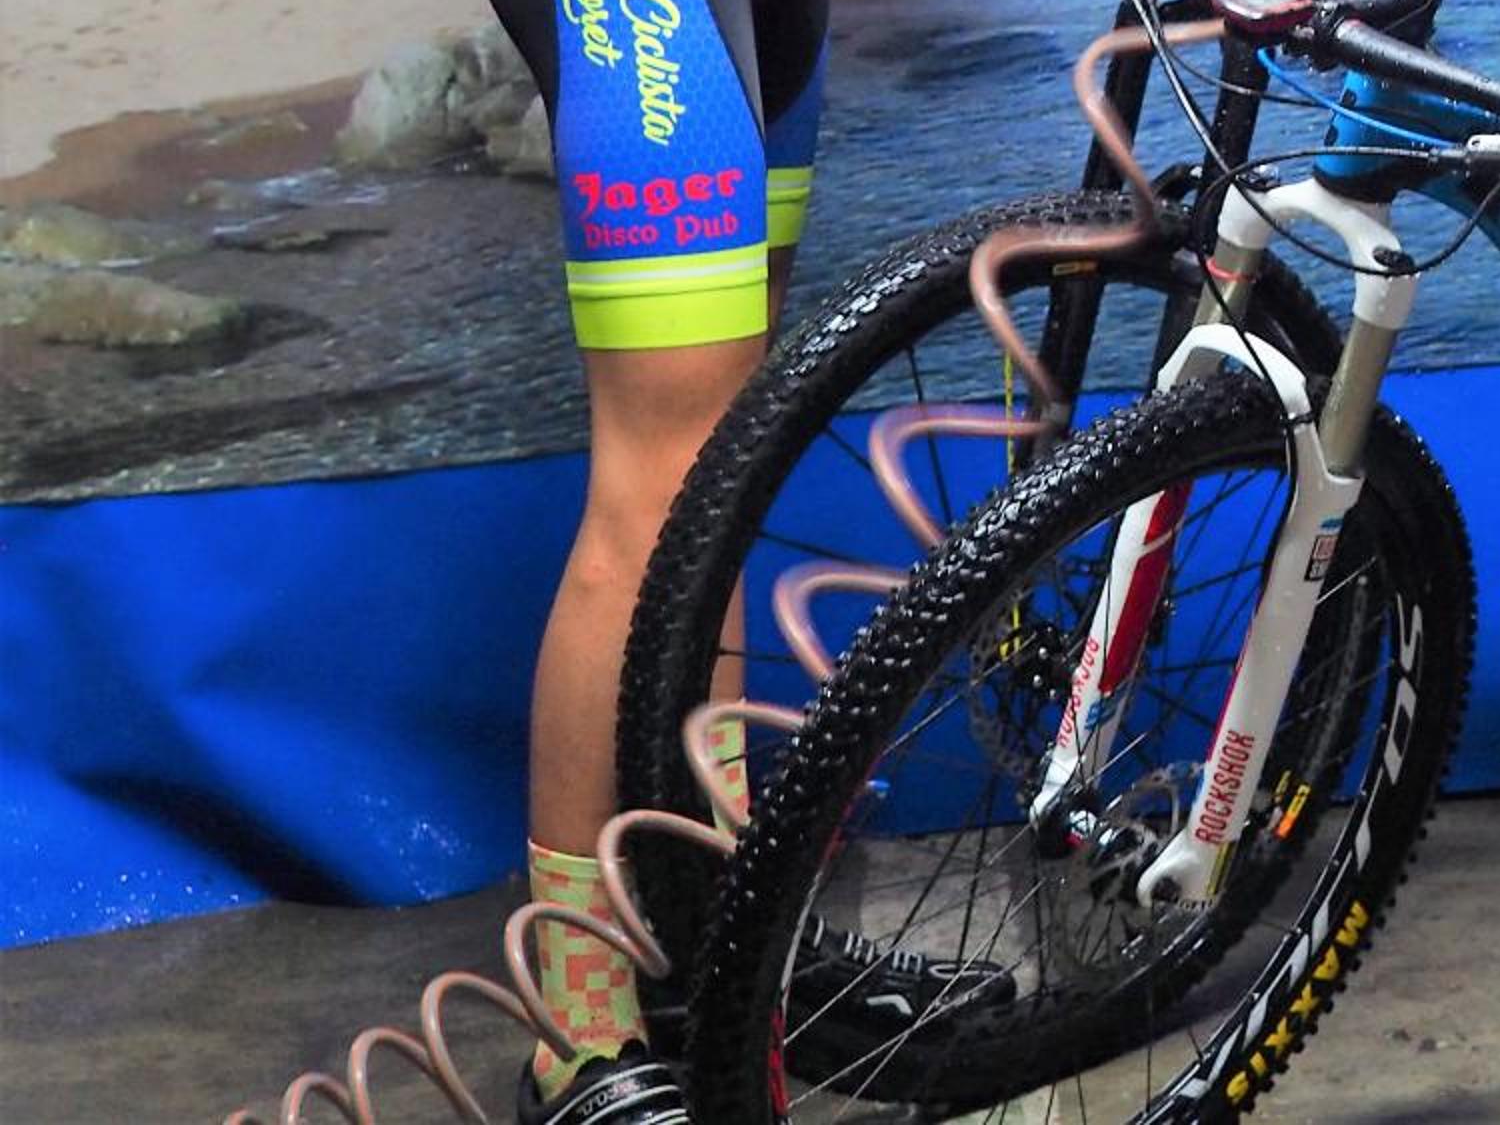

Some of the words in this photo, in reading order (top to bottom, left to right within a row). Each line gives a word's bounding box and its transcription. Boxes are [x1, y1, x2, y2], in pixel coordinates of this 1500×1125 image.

[572, 167, 743, 220] Jager
[585, 223, 658, 249] Disco
[675, 212, 740, 246] Pub
[1194, 729, 1256, 847] ROCKSHOX
[1225, 898, 1369, 1101] MAXXIS
